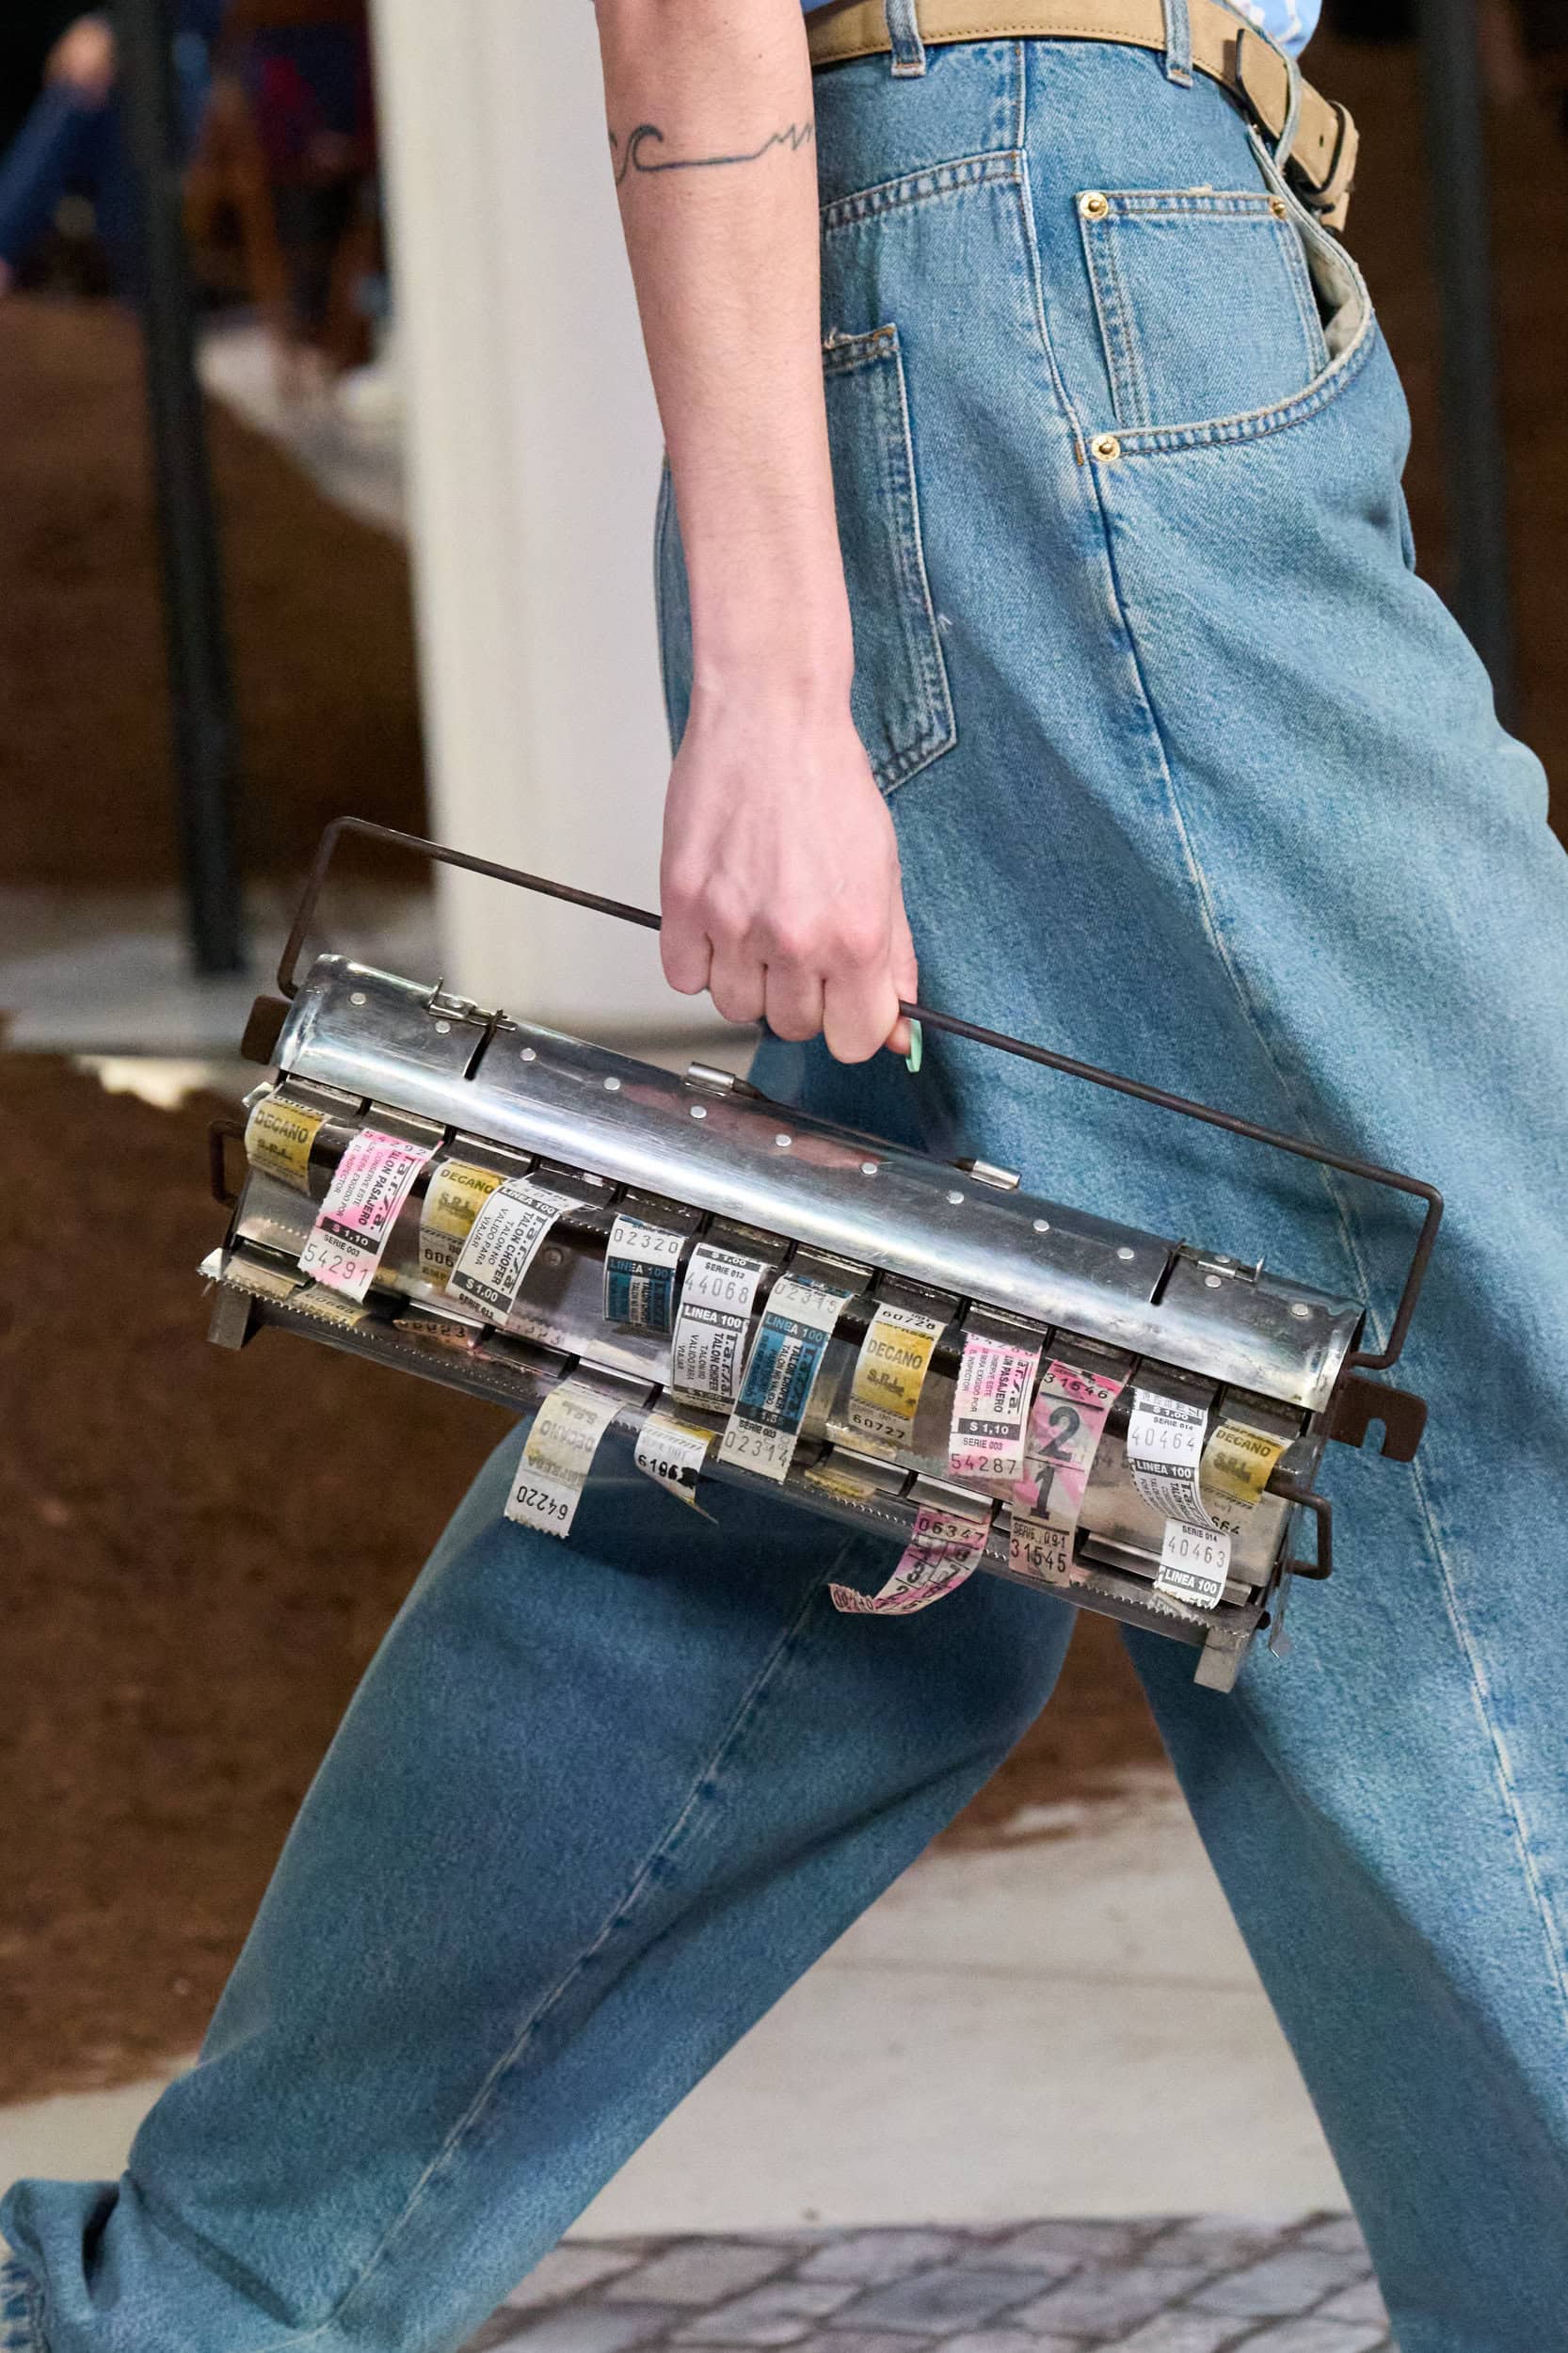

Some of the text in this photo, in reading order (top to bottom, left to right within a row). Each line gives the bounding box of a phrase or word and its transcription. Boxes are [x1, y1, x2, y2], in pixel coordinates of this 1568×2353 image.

[254, 1110, 309, 1144] DECANO
[440, 1168, 494, 1194] DECANO
[358, 1175, 387, 1226] PASAJERO
[535, 1200, 555, 1215] 100
[323, 1233, 347, 1252] SERIE
[471, 1216, 491, 1249] VIAJAR
[474, 1208, 509, 1266] VALIDO PARA
[488, 1221, 516, 1266] TALON NO
[613, 1227, 679, 1255] 02320
[490, 1211, 534, 1287] TALON CHOFER
[304, 1243, 370, 1288] 54291
[704, 1261, 729, 1276] SERIE
[683, 1272, 750, 1305] 44068
[682, 1305, 742, 1329] LINEA 100
[764, 1315, 824, 1344] LINEA 100
[882, 1310, 936, 1331] 60728
[710, 1333, 725, 1361] TALON
[867, 1339, 923, 1370] DECANO
[994, 1366, 1012, 1413] PASAJERO
[852, 1414, 906, 1440] 60727
[1038, 1405, 1080, 1463] 2
[1153, 1417, 1178, 1429] SERIE
[724, 1431, 788, 1467] 02314
[963, 1437, 988, 1449] SERIE
[1130, 1427, 1196, 1453] 40464
[1216, 1429, 1272, 1458] DECANO
[950, 1452, 1017, 1475] 54287
[1136, 1461, 1192, 1480] LINEA 100
[517, 1485, 569, 1521] 64220
[1030, 1465, 1056, 1520] 1
[919, 1517, 984, 1542] 06347
[1181, 1524, 1204, 1538] SERIE
[1011, 1538, 1067, 1574] 31545
[1167, 1535, 1225, 1569] 40463
[1164, 1567, 1218, 1595] LINEA 100
